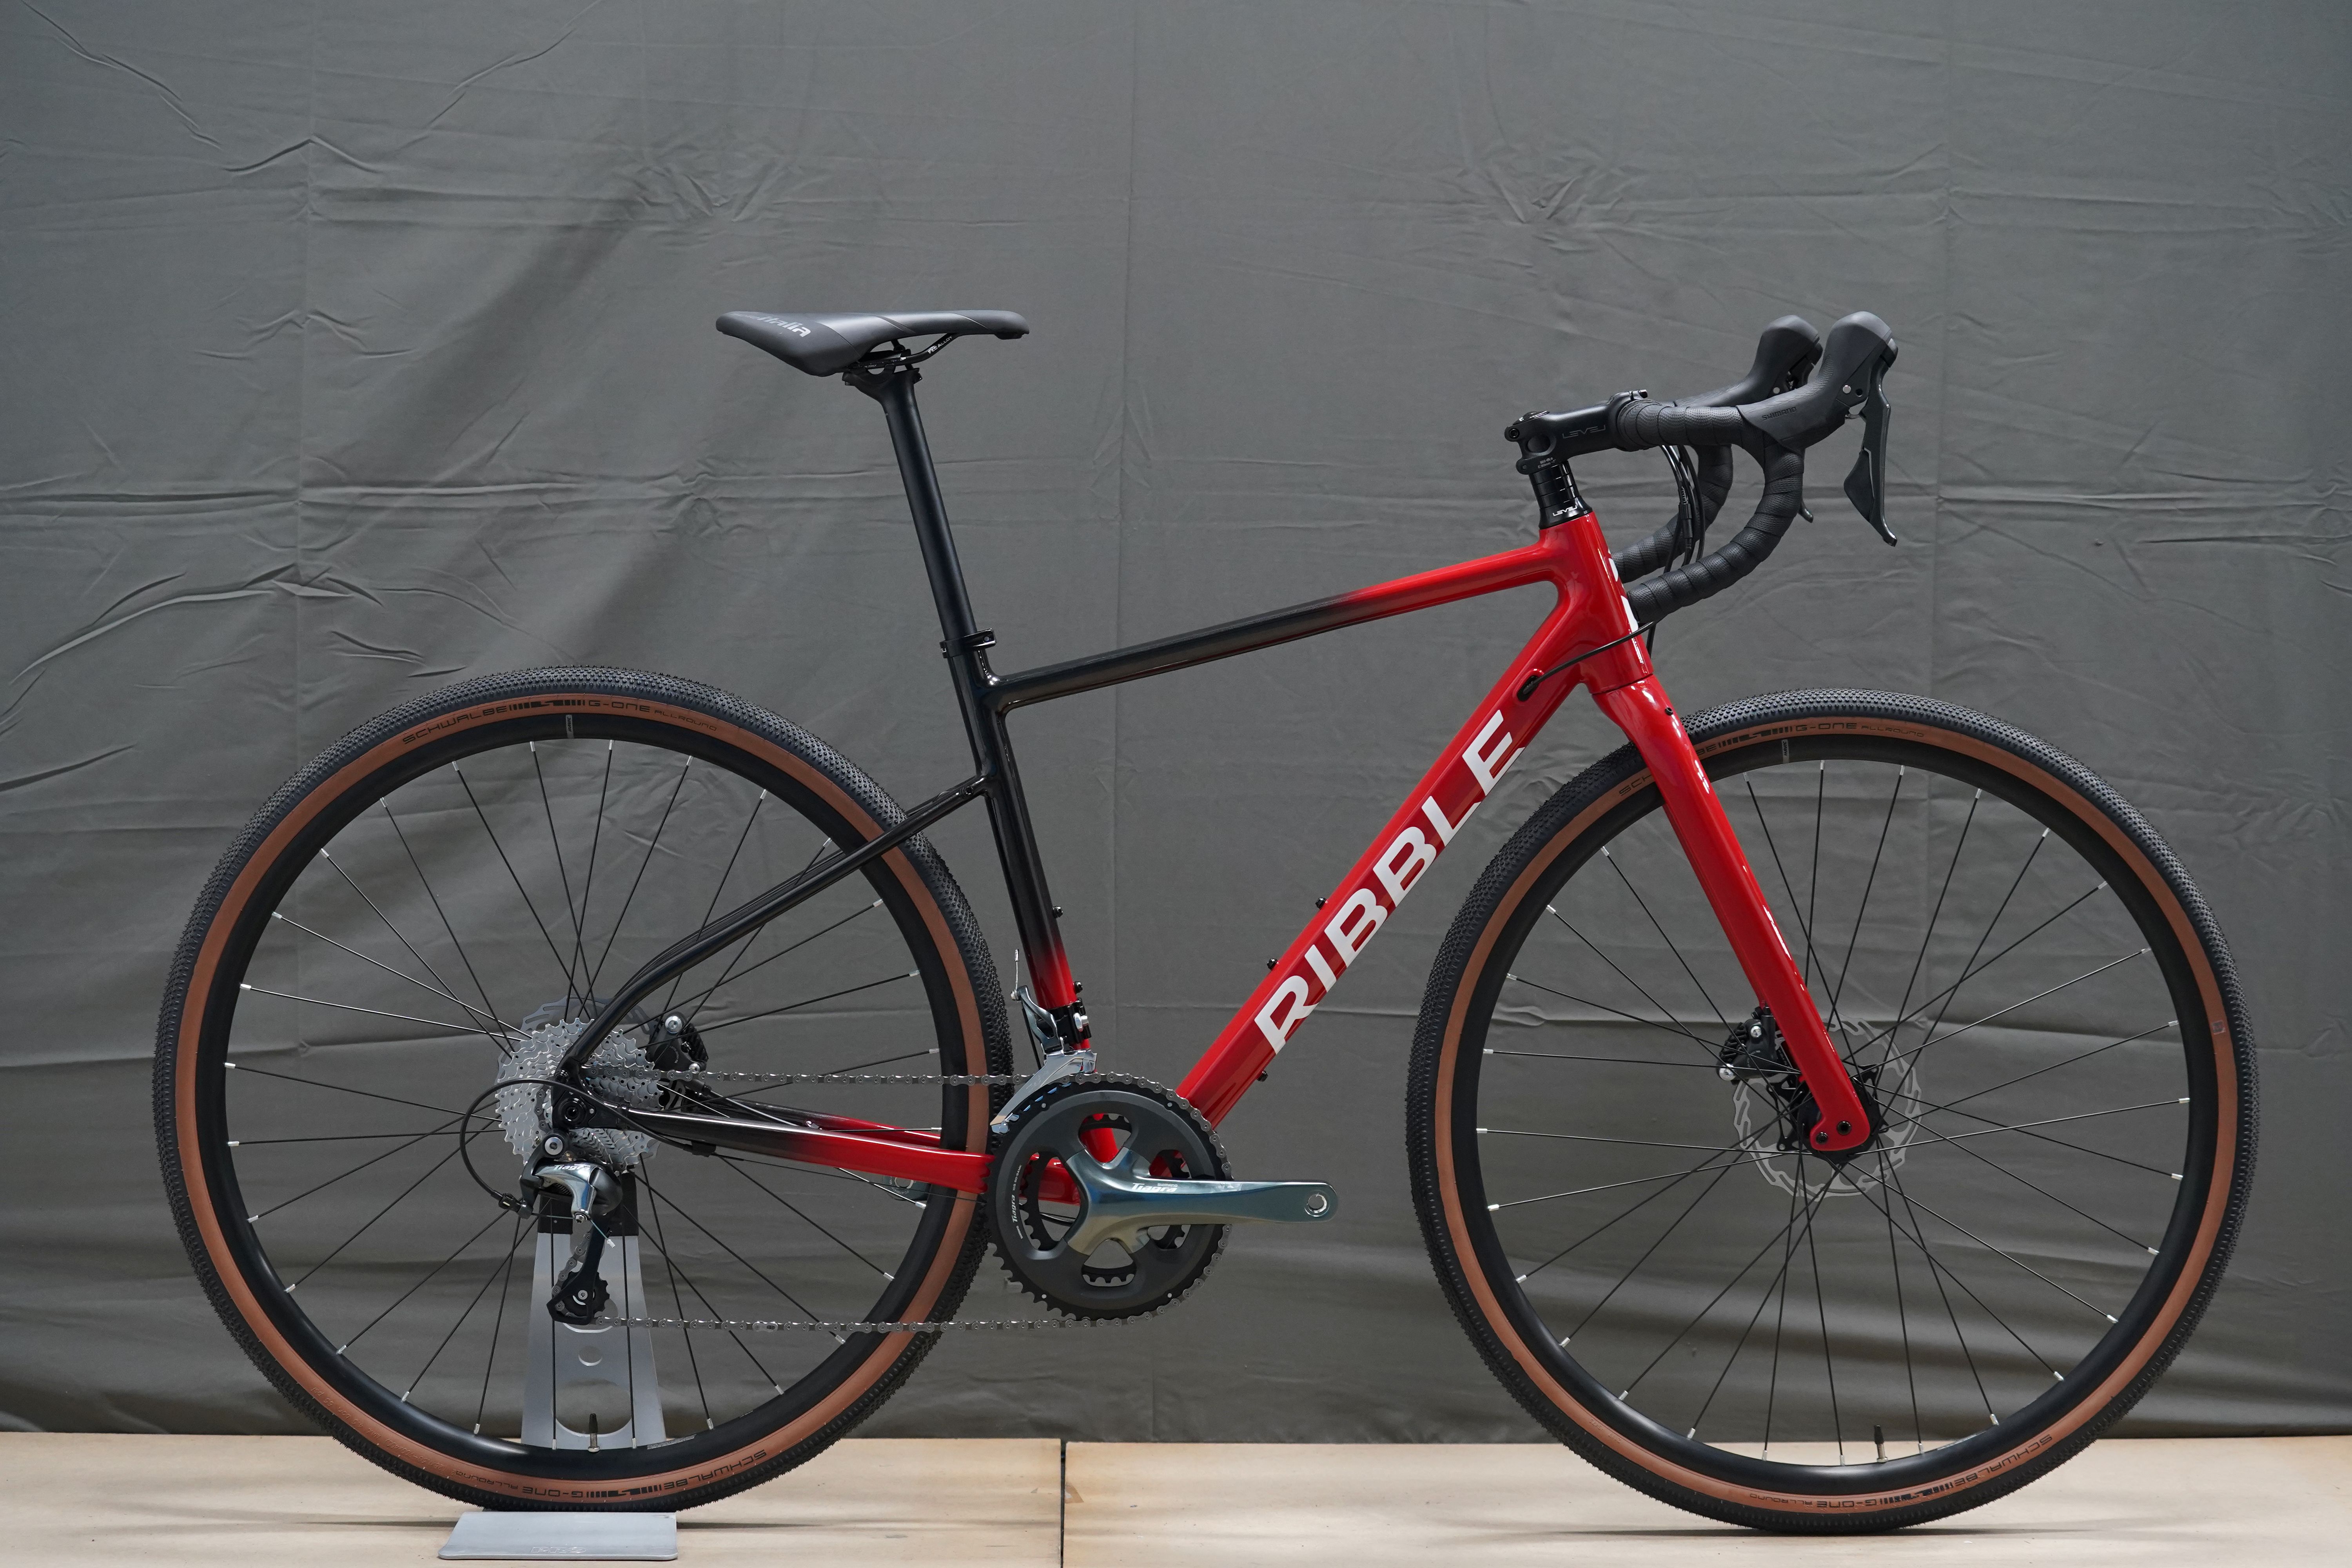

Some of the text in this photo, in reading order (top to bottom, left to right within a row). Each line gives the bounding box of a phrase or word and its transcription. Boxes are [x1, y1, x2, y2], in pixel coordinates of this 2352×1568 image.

[937, 336, 953, 347] ALLOY
[1762, 407, 1797, 421] SHIMANO
[403, 700, 717, 744] SCHWALBE G-ONE ALLROUND
[1796, 723, 1857, 731] G-ONE
[1861, 725, 1924, 737] ALLROUND
[1254, 710, 1526, 1055] RIBBLE
[1131, 1183, 1178, 1192] Tiagra
[1954, 1434, 2052, 1486] SCHWALBE
[456, 1449, 766, 1498] SCHWALBE G-ONE ALLROUND
[1750, 1493, 1812, 1505] ALLROUND
[1817, 1499, 1877, 1508] G-ONE
